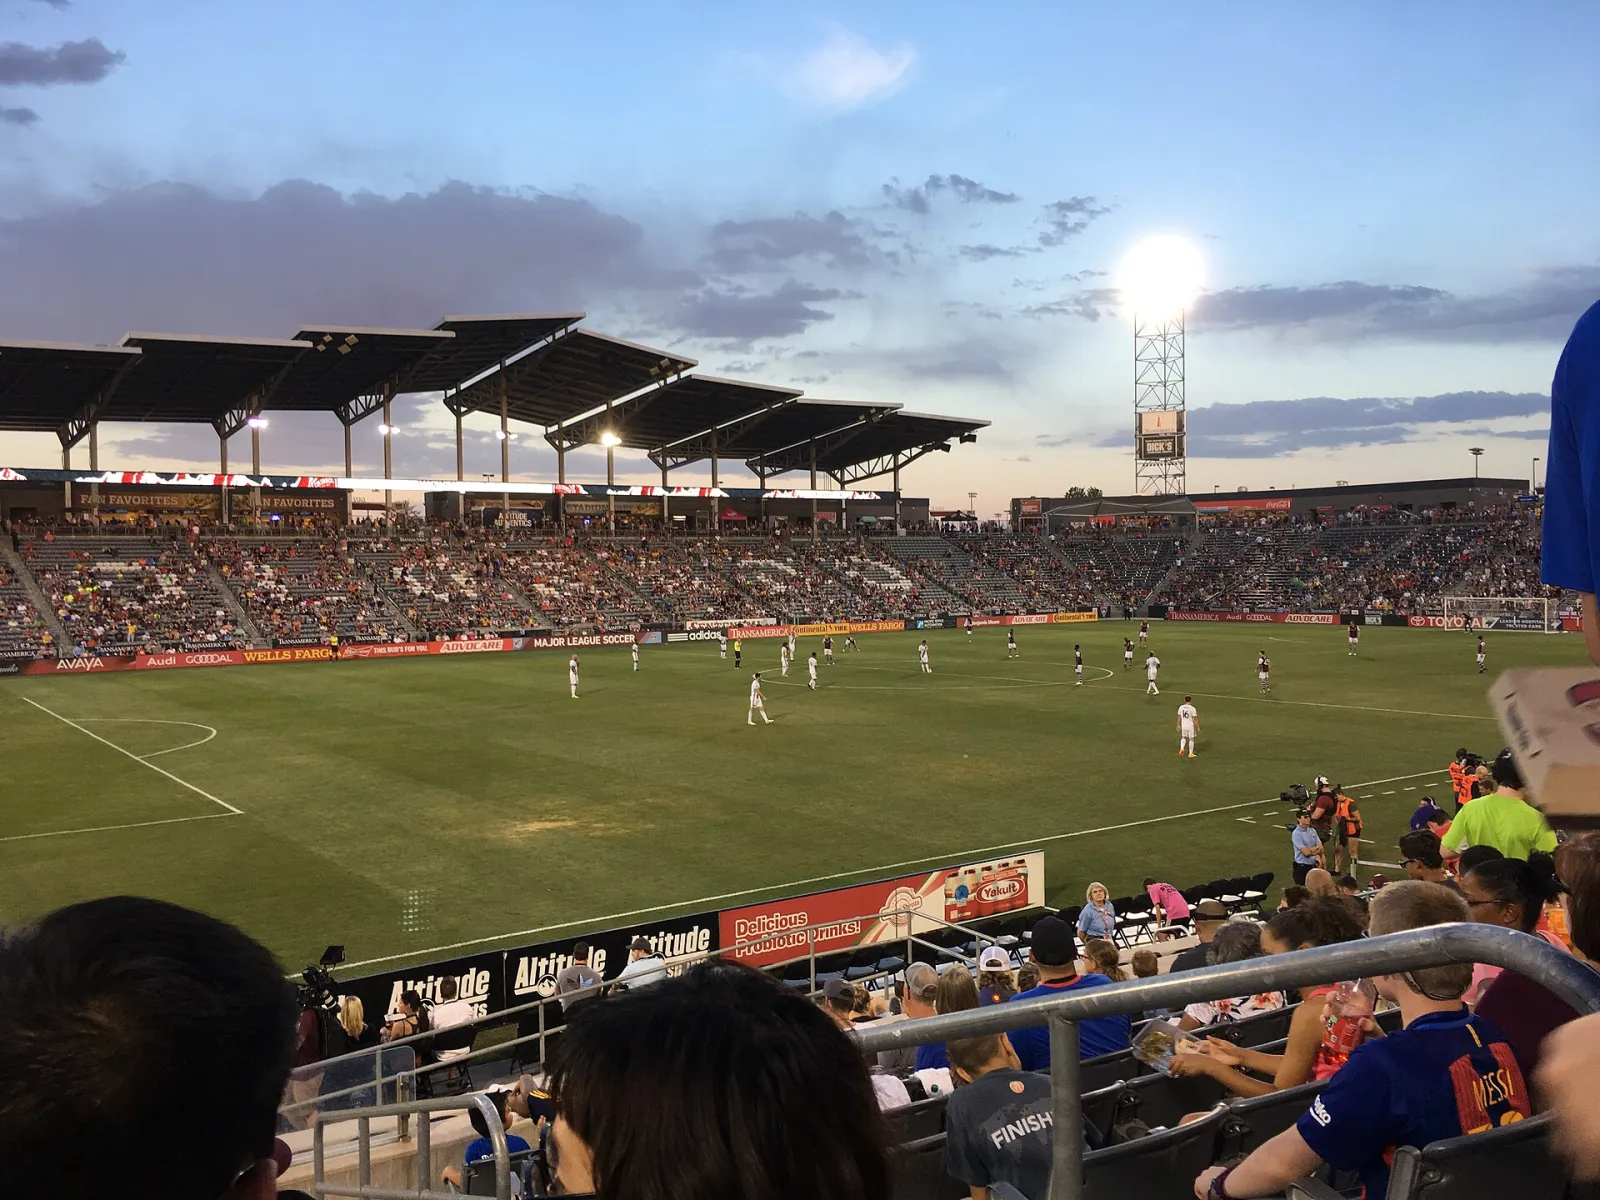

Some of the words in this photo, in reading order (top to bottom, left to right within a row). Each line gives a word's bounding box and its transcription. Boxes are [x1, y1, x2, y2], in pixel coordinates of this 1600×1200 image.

[1147, 442, 1172, 452] DICK'S
[109, 495, 178, 504] FAVORITES
[274, 498, 334, 507] FAVORITES
[1012, 615, 1047, 624] ADVOCARE
[1170, 612, 1219, 621] TRANSAMERICA
[1285, 614, 1332, 622] ADVOCARE
[850, 624, 877, 632] WELLS
[879, 622, 904, 630] FARGO
[1427, 616, 1482, 628] TOYOA
[689, 630, 721, 640] adidas
[730, 628, 788, 638] TRANSAMERICA
[534, 636, 565, 648] MAJOR
[568, 636, 601, 646] LEAGUE
[603, 634, 635, 645] SOCCER
[440, 641, 503, 652] ADVOCARE
[244, 651, 290, 662] WELLS
[56, 658, 104, 671] AVAYA
[147, 658, 176, 666] Audi
[1182, 710, 1189, 719] 16
[984, 883, 1018, 898] Yakult
[736, 912, 807, 938] Delicious
[736, 930, 806, 957] Probiotic
[1472, 1068, 1514, 1112] MESSI
[991, 1111, 1053, 1150] FINISH
